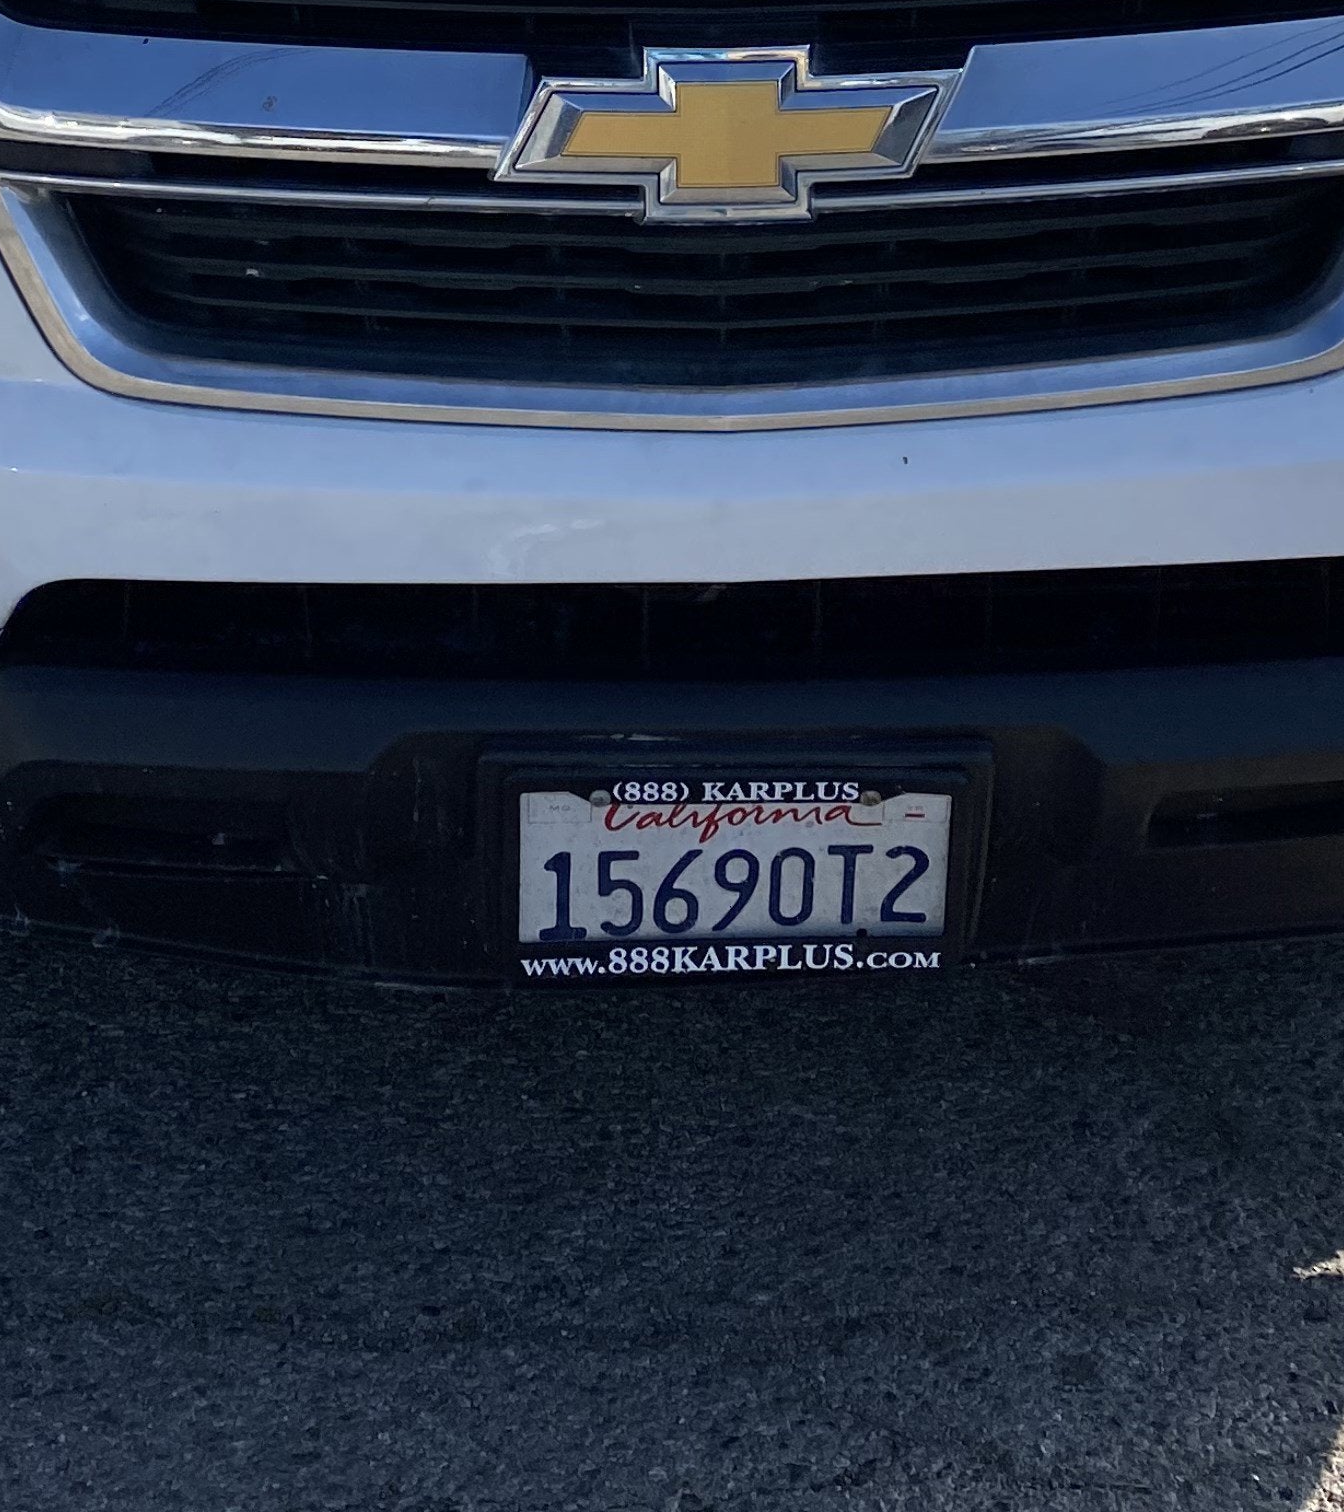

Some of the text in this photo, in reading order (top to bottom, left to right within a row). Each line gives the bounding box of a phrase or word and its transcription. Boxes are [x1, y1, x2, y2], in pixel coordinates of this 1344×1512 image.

[612, 781, 860, 802] (888) KARPLUS
[602, 801, 883, 844] California
[538, 844, 931, 943] 15690T2
